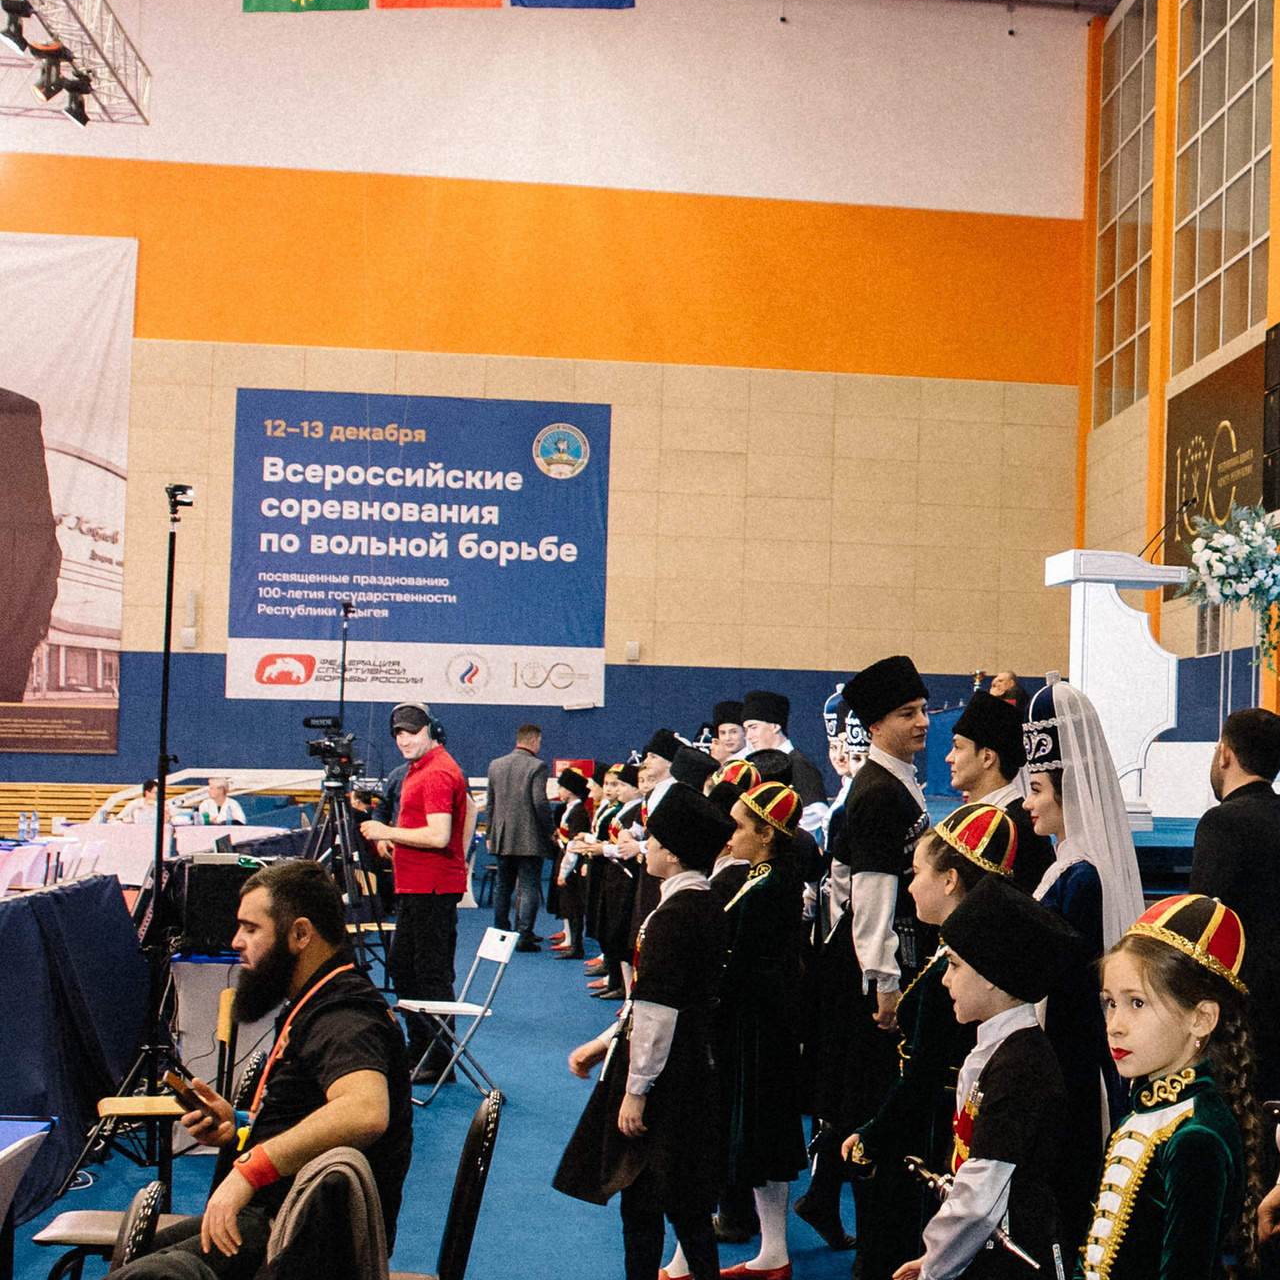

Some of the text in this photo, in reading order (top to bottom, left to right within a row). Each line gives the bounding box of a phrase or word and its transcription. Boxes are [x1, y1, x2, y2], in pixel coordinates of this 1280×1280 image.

[264, 419, 427, 445] 12–13 декабря
[262, 456, 524, 491] Всероссийские
[260, 497, 499, 525] соревнования
[260, 532, 578, 566] по вольной борьбе
[258, 572, 450, 587] посвященные празднованию
[258, 587, 456, 604] 100-летия государственности
[257, 604, 336, 618] Республики
[370, 675, 424, 684] РОССИИ
